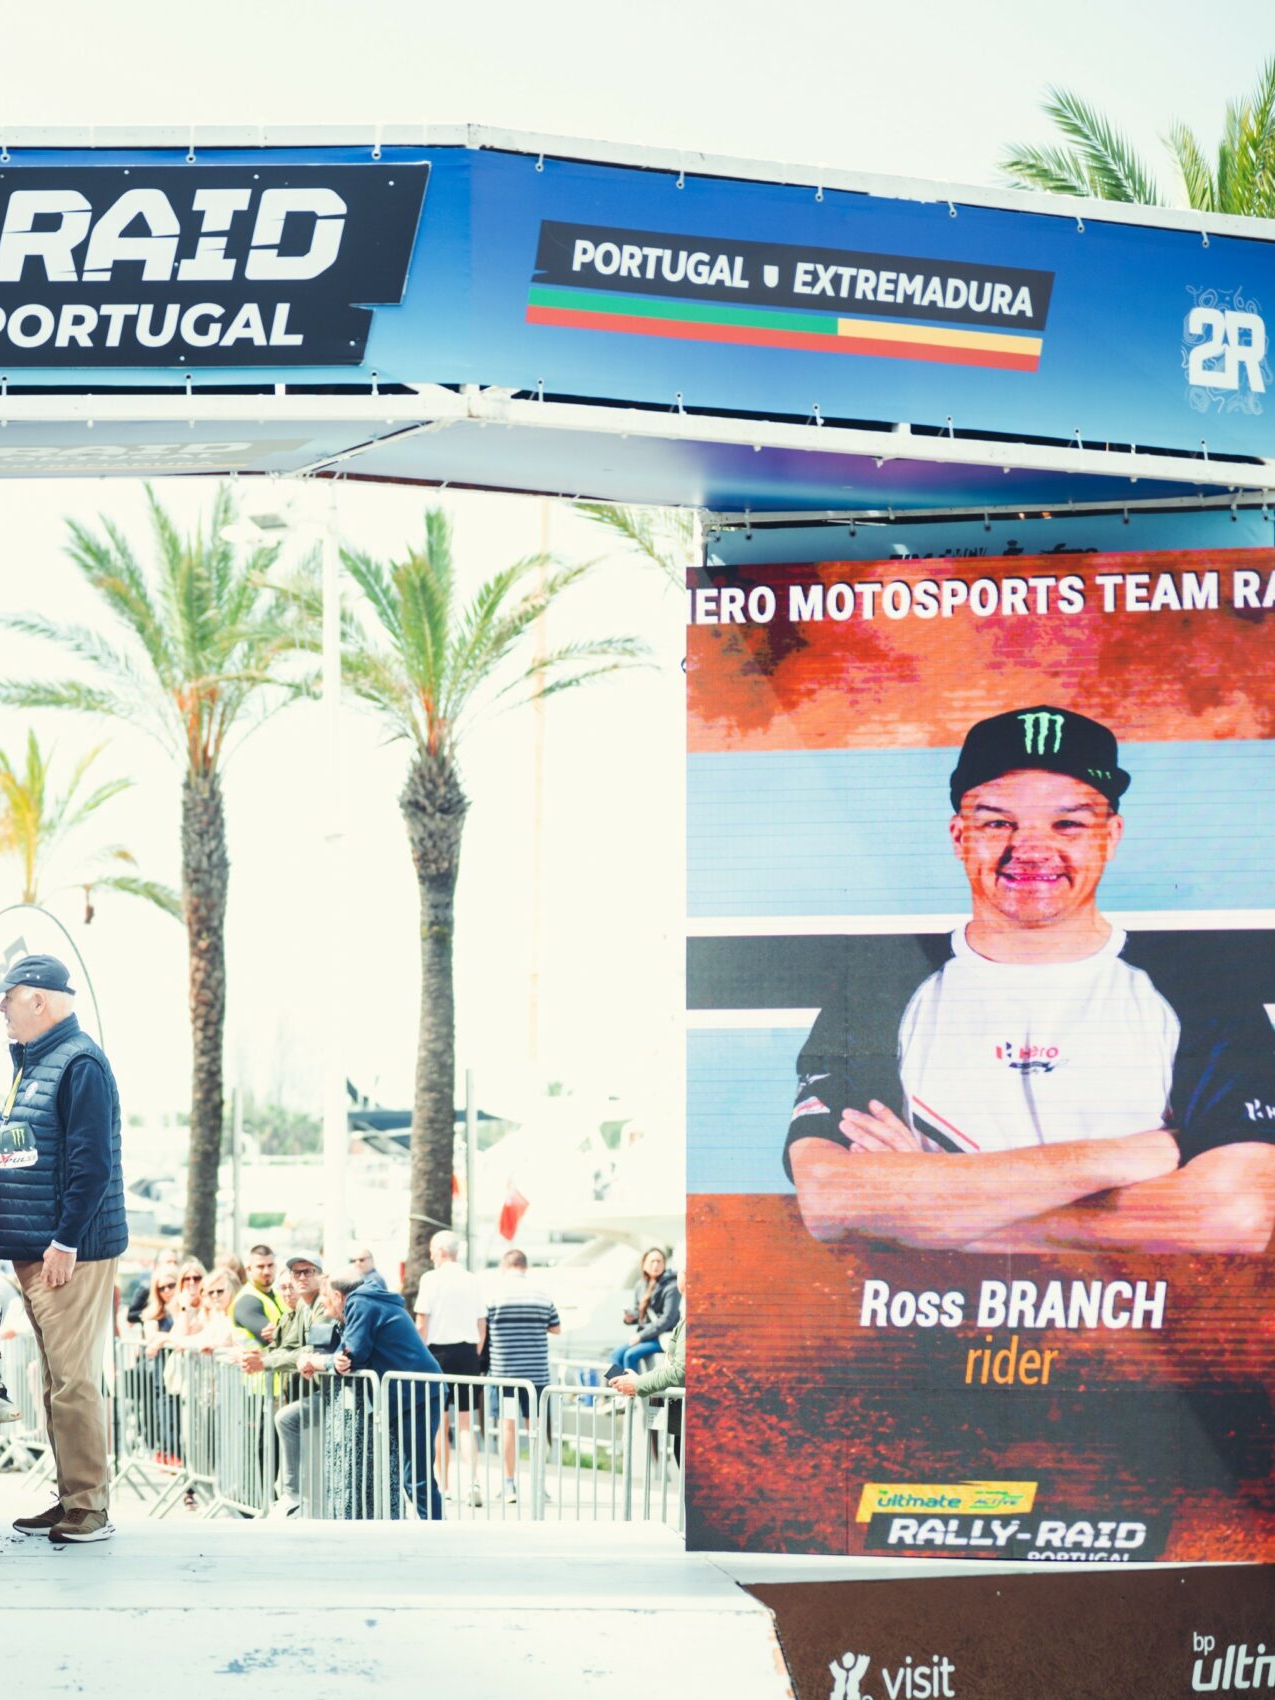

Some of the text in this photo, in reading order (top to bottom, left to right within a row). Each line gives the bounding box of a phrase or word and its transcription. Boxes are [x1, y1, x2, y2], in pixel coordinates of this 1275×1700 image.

[572, 239, 1033, 318] PORTUGAL EXTREMADURA
[1188, 306, 1266, 394] 2R
[788, 575, 1086, 622] MOTOSPORTS
[1095, 572, 1219, 614] TEAM
[860, 1279, 1167, 1330] Ross BRANCH
[964, 1335, 1059, 1385] rider
[877, 1493, 962, 1509] ultimate
[887, 1517, 1147, 1549] RALLY-RAID
[1193, 1631, 1215, 1656] bp
[882, 1654, 956, 1700] visit
